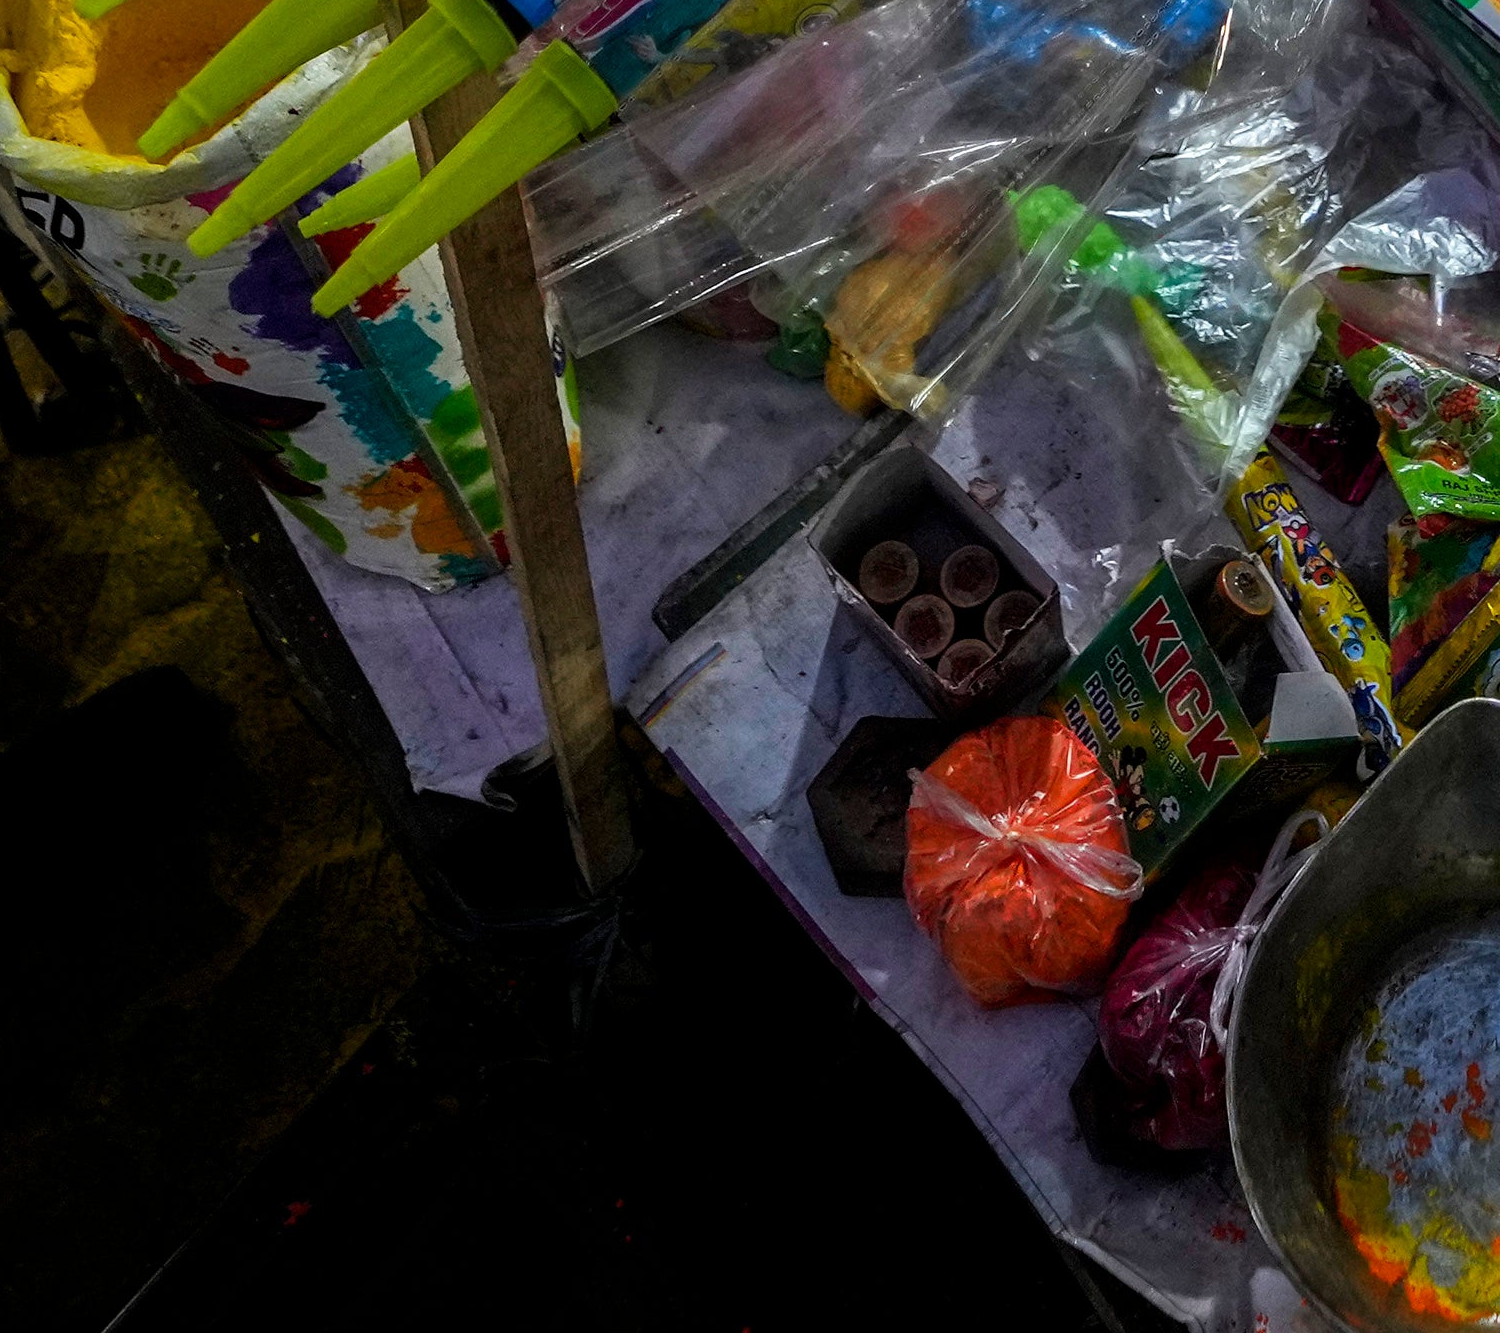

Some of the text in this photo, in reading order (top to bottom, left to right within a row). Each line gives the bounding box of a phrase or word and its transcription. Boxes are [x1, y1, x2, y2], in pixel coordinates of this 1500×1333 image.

[1082, 670, 1123, 744] ROOH
[1105, 645, 1145, 723] 500%
[1129, 594, 1241, 792] KICK
